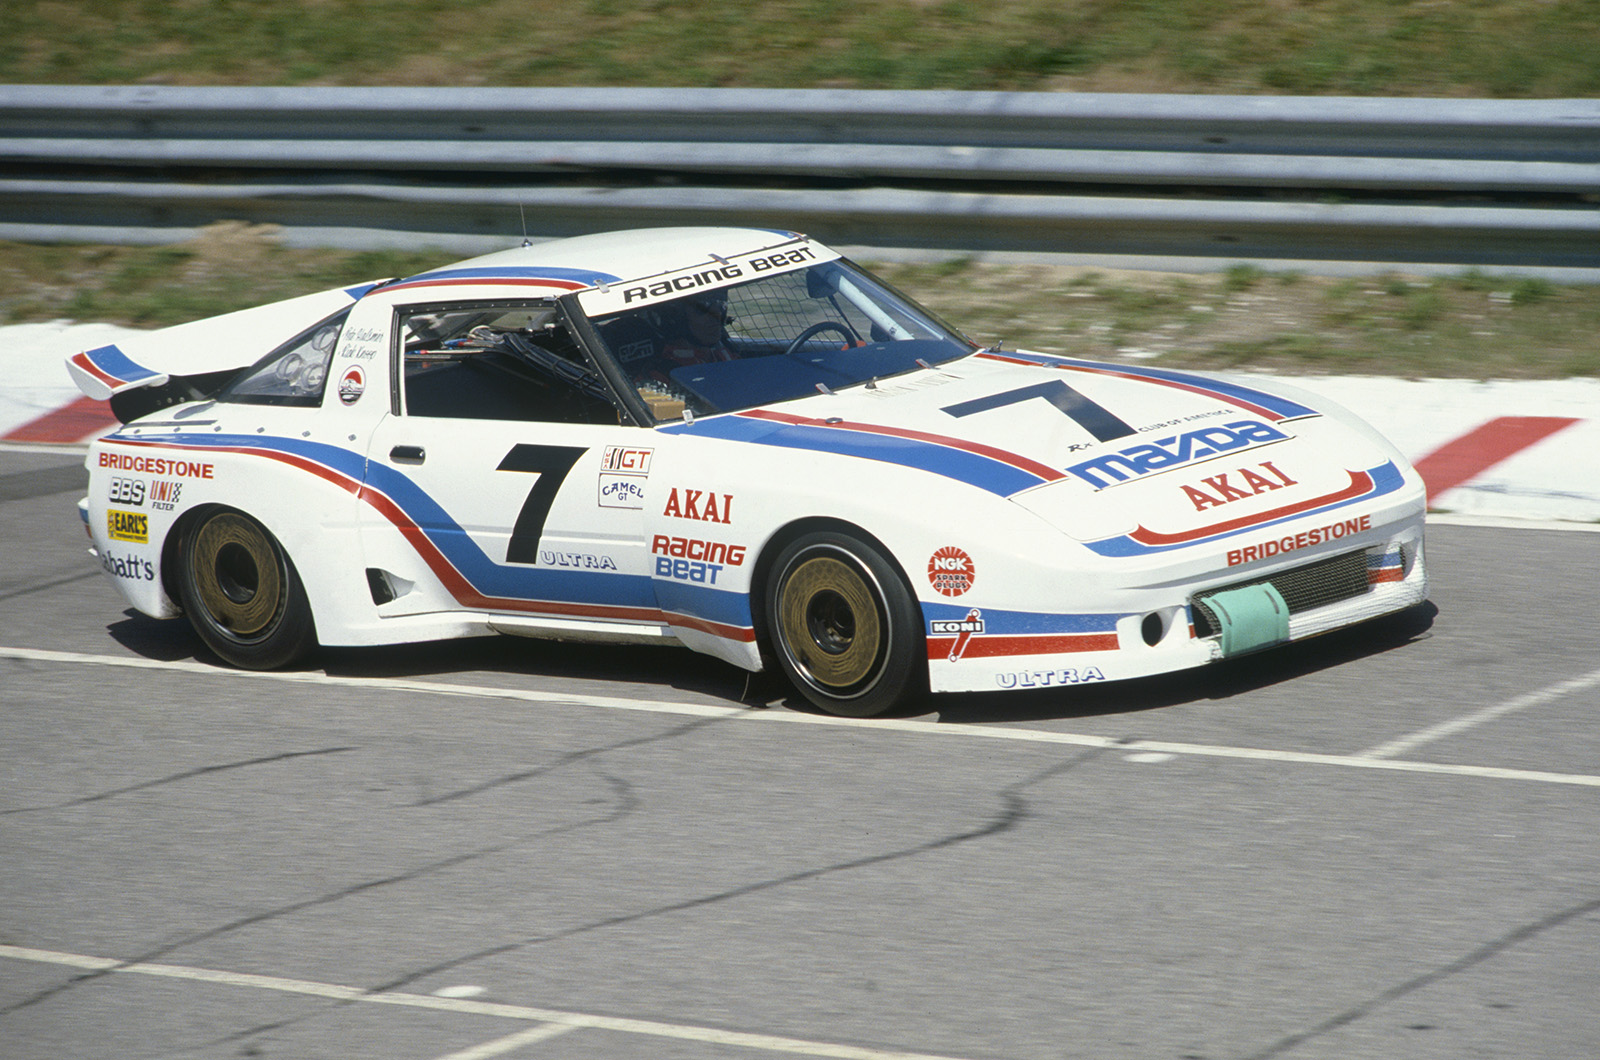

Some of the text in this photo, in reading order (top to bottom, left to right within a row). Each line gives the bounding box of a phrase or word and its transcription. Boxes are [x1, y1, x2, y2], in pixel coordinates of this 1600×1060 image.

[939, 379, 1138, 443] 7
[1138, 423, 1168, 433] CLUB
[98, 452, 214, 479] BRIDGESTONE
[622, 450, 651, 469] GT
[109, 476, 146, 507] BBS
[602, 482, 644, 498] CAMEL
[617, 492, 628, 501] GT
[1180, 461, 1299, 512] AKAI
[152, 502, 175, 511] FILTER
[495, 443, 591, 564] 7
[663, 487, 733, 524] AKAI
[115, 512, 148, 535] EARL'S
[1227, 514, 1371, 567] BRIDGESTONE
[540, 550, 617, 571] ULTRA
[934, 557, 968, 571] NGK
[933, 622, 982, 632] KONI
[995, 666, 1105, 688] ULTRA
